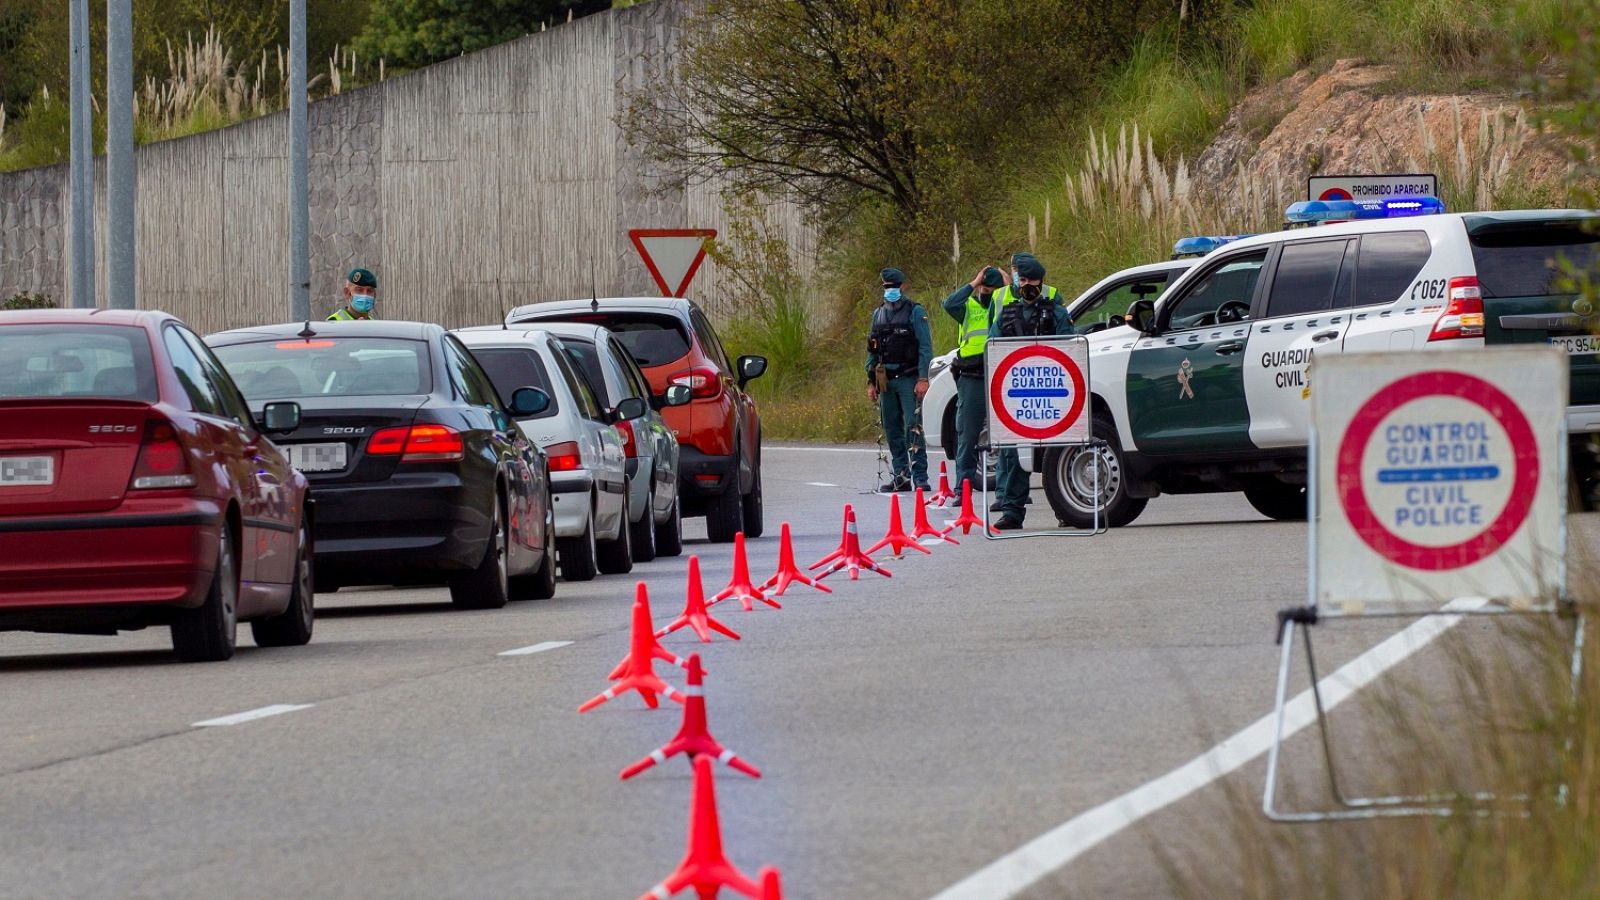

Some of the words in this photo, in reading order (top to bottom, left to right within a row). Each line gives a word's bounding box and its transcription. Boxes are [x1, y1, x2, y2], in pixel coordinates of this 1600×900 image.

[1352, 184, 1391, 195] PROHIBIDO
[1394, 183, 1429, 194] APARCAR
[1421, 279, 1446, 299] 062
[1261, 348, 1314, 368] GUARDIA
[1011, 366, 1066, 377] CONTROL
[1275, 370, 1304, 388] CIVIL
[1011, 378, 1064, 388] GUARDIA
[1021, 398, 1054, 409] CIVIL
[1016, 409, 1061, 420] POLICE
[1385, 421, 1491, 444] CONTROL
[1386, 444, 1489, 465] GUARDIA
[1405, 485, 1470, 505] CIVIL
[1395, 505, 1483, 527] POLICE
